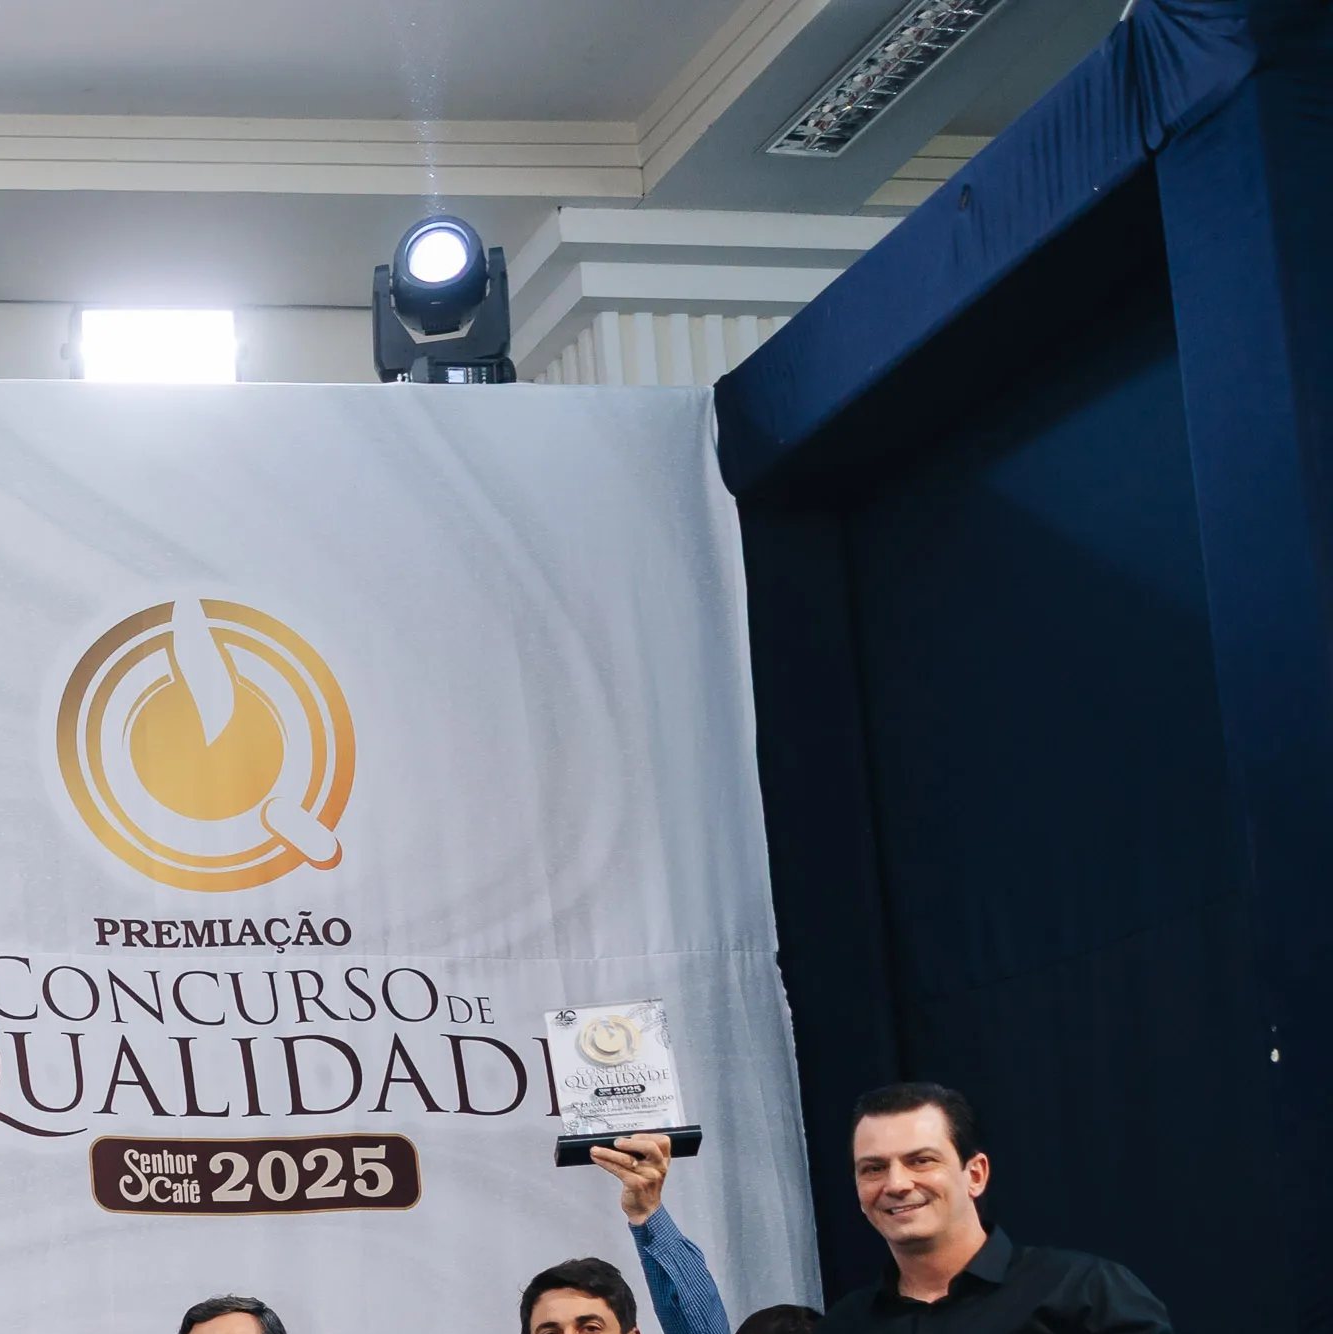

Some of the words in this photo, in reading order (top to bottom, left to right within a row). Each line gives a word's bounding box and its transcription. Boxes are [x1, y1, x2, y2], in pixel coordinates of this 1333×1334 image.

[94, 911, 351, 953] PREMIAÇÃO
[445, 995, 494, 1025] DE
[564, 1069, 670, 1089] QUALIDADE
[576, 1063, 646, 1075] CONCURSO
[613, 1085, 642, 1095] 2025
[119, 1148, 198, 1203] Senhor
[208, 1145, 394, 1203] 2025
[149, 1177, 200, 1205] Café
